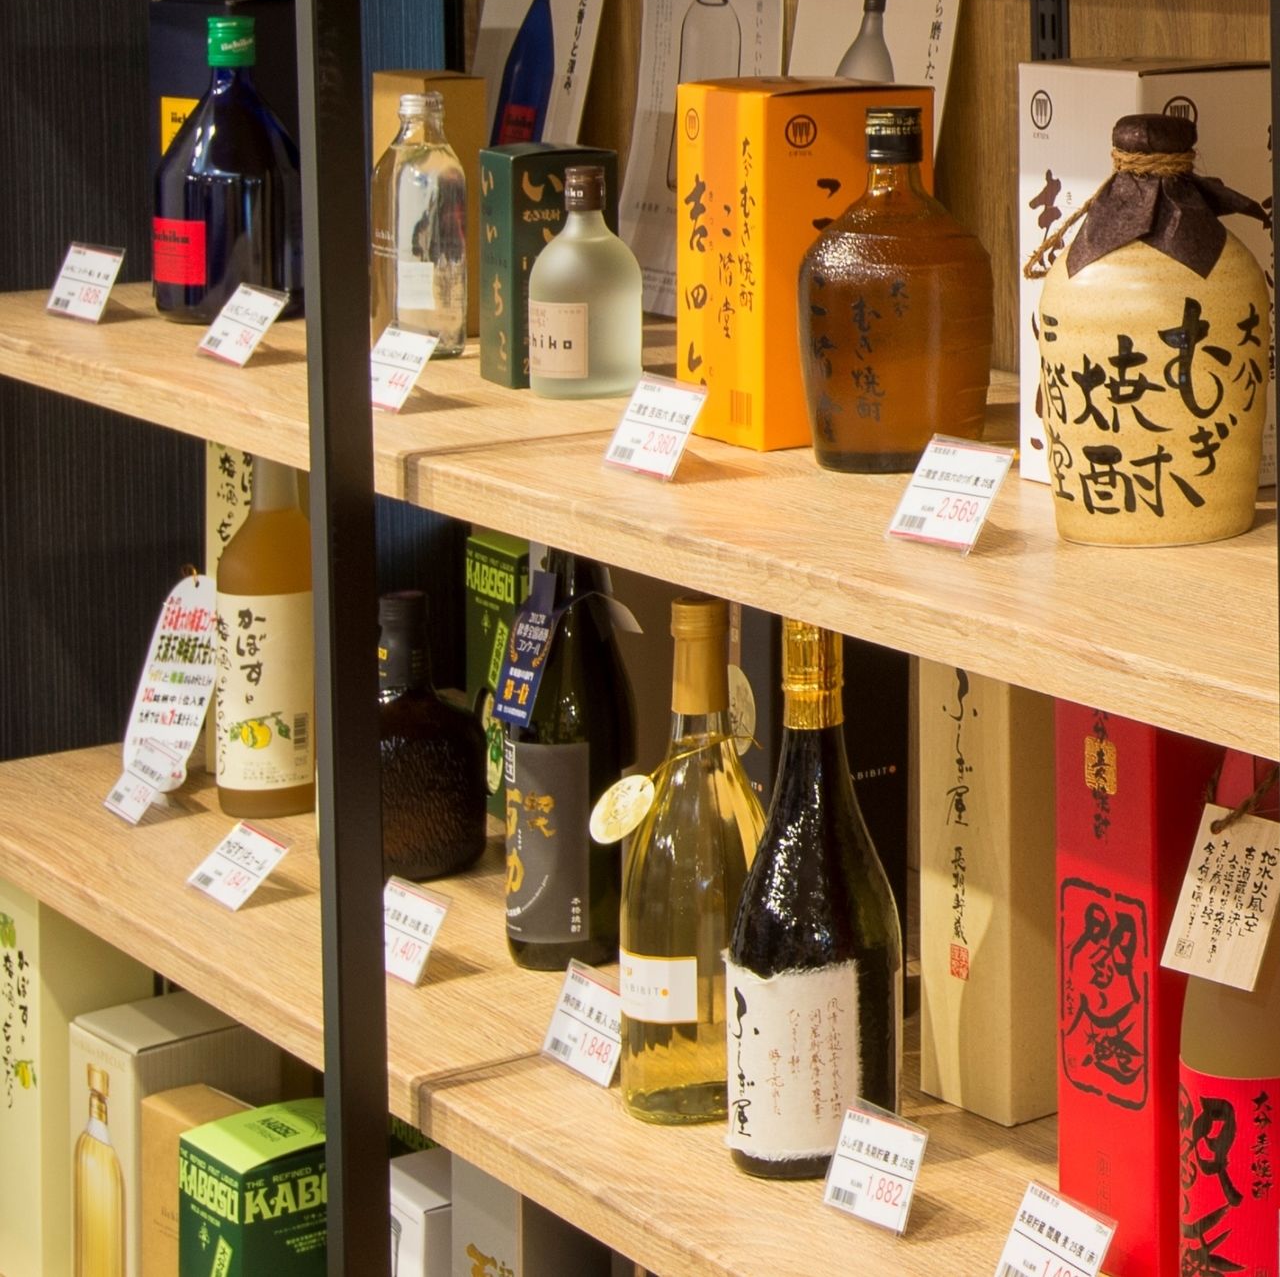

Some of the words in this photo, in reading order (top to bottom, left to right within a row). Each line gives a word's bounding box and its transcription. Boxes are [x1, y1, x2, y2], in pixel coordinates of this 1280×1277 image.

[1236, 302, 1264, 413] 大分
[1157, 297, 1238, 476] むぎ
[1071, 333, 1206, 518] 焼酎
[643, 431, 675, 455] 2,360
[936, 495, 980, 524] 2,569
[580, 1032, 612, 1065] 1,848
[179, 1156, 239, 1225] KABOSU
[245, 1178, 265, 1189] THE
[272, 1166, 312, 1183] REFINED
[866, 1174, 904, 1208] 1,882
